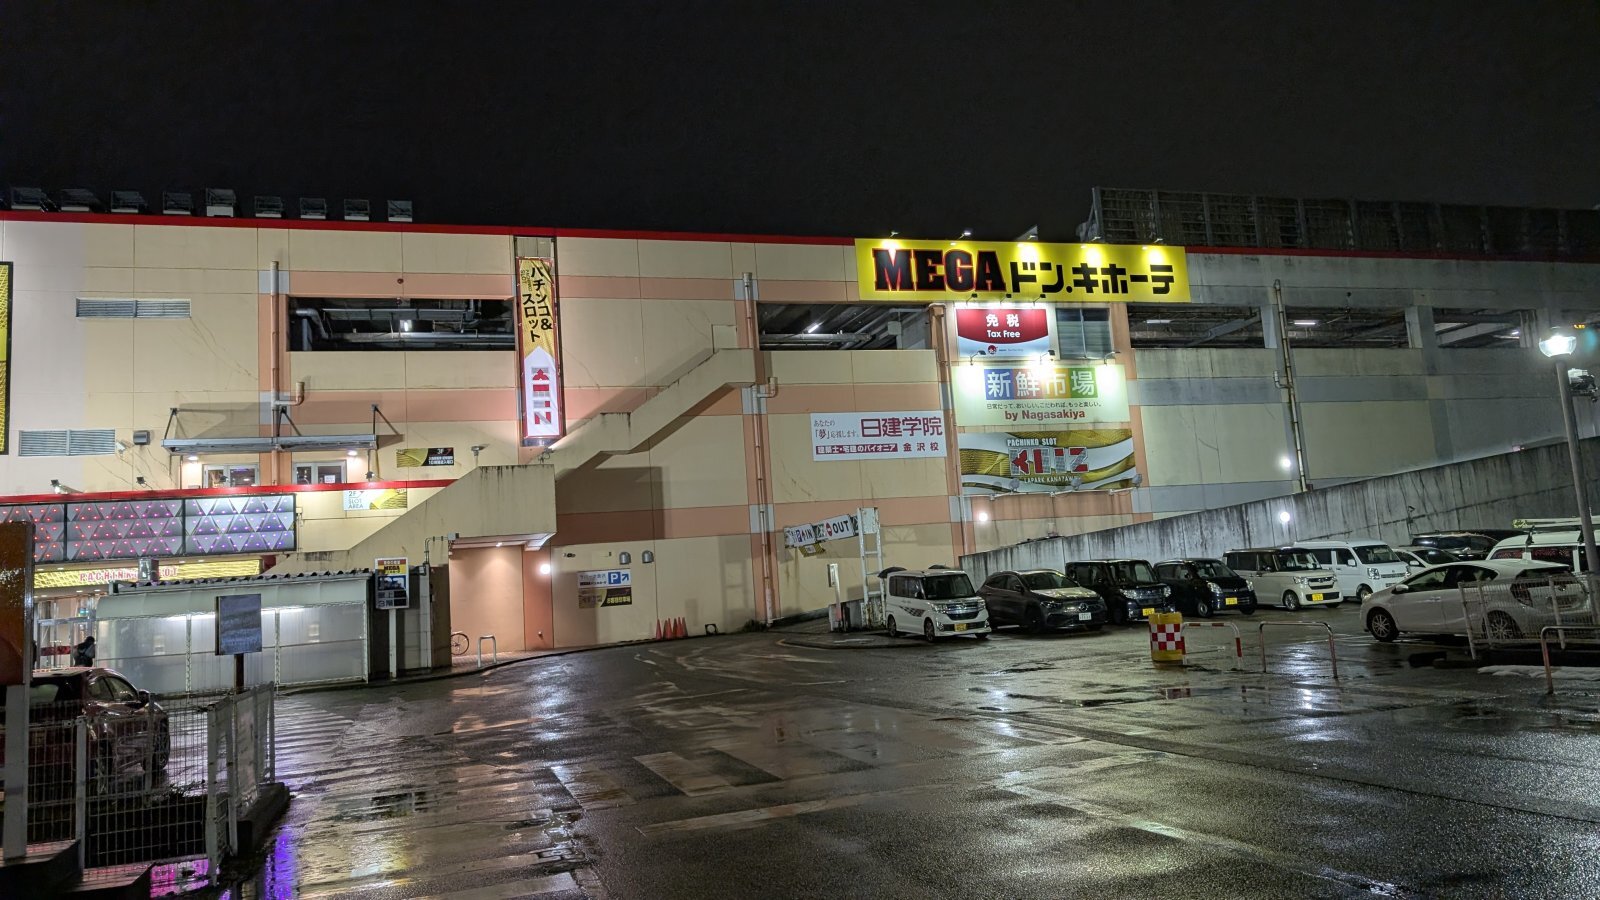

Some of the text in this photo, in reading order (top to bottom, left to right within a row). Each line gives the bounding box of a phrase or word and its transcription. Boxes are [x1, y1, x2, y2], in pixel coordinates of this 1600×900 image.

[871, 247, 1007, 293] MEGA
[522, 293, 541, 343] スロット
[985, 313, 1020, 328] 免税
[986, 330, 1021, 338] Tax Free
[986, 369, 1096, 399] 新鮮市場
[1004, 408, 1086, 421] by Nagasakiya
[860, 416, 943, 438] 日建学院
[903, 441, 939, 452] 金沢校
[1007, 437, 1057, 447] PACHINKO SLOT
[832, 520, 850, 534] OUT
